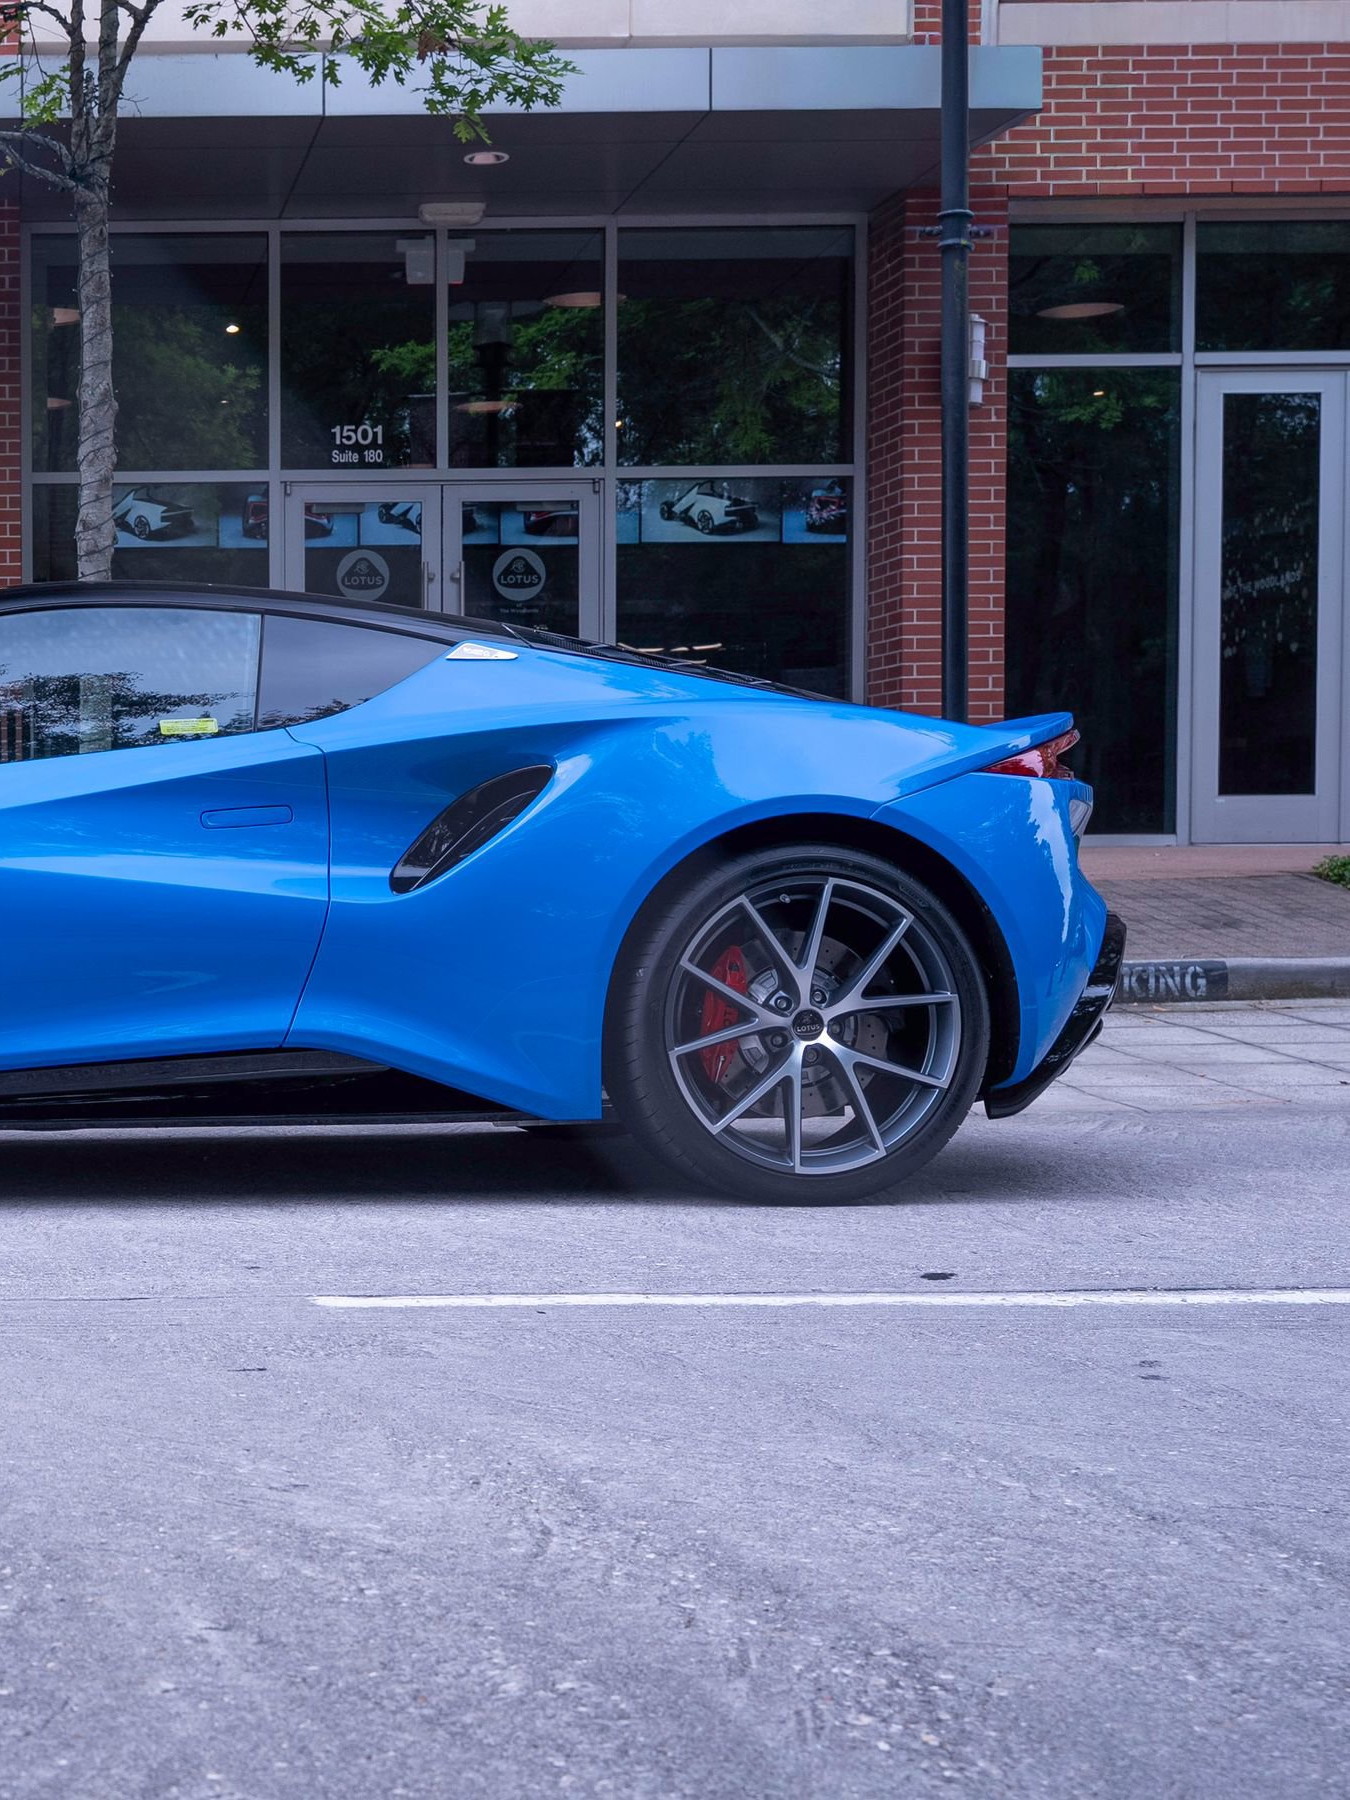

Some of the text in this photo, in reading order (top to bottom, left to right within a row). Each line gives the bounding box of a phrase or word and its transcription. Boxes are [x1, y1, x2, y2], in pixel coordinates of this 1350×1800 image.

[331, 425, 383, 445] 1501
[332, 450, 383, 463] Suite 180
[344, 576, 383, 585] LOTUS
[500, 574, 539, 584] LOTUS
[1121, 965, 1207, 997] KING
[797, 1024, 820, 1032] LOTUS
